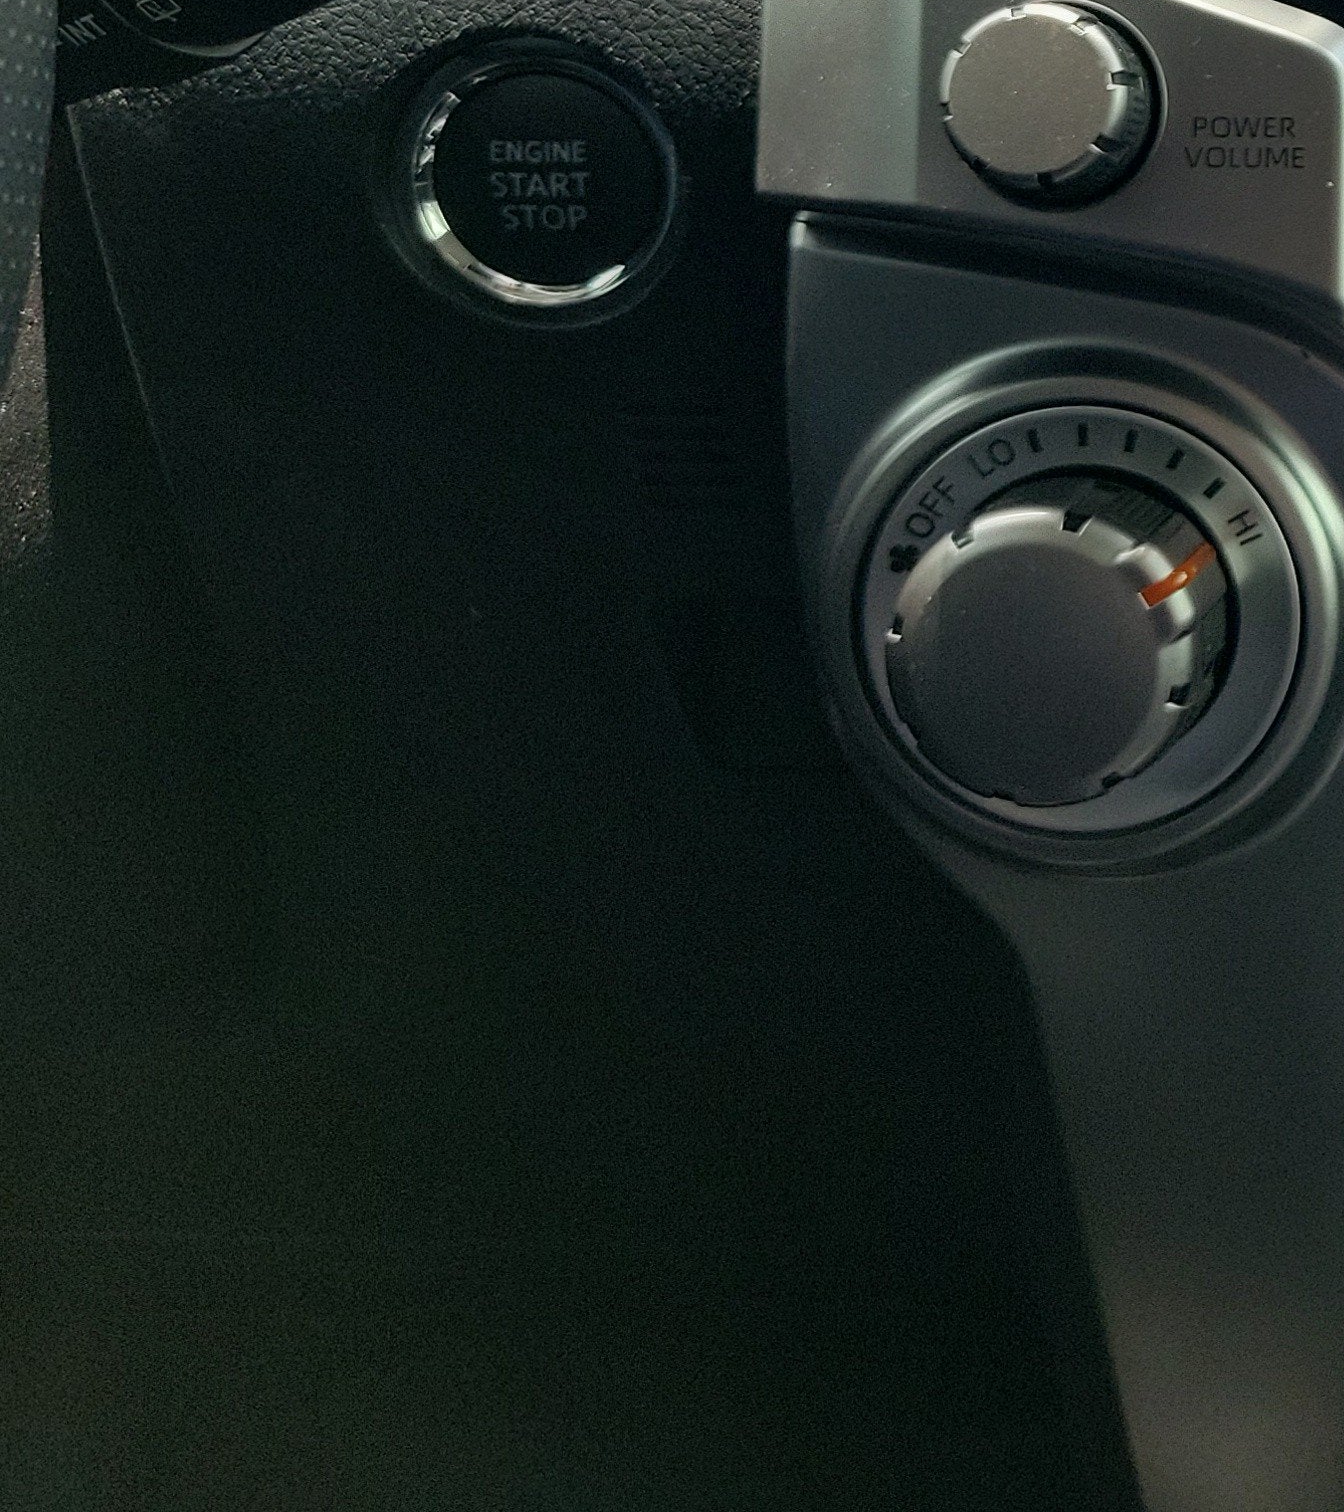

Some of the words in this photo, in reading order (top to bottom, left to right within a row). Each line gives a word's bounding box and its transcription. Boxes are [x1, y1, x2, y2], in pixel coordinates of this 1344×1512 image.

[1193, 116, 1295, 138] POWER
[489, 140, 588, 163] ENGINE
[1184, 146, 1306, 168] VOLUME
[490, 171, 591, 198] START
[501, 204, 588, 231] STOP
[967, 438, 1016, 477] LO
[905, 476, 956, 539] OFF
[1227, 509, 1262, 546] HI
